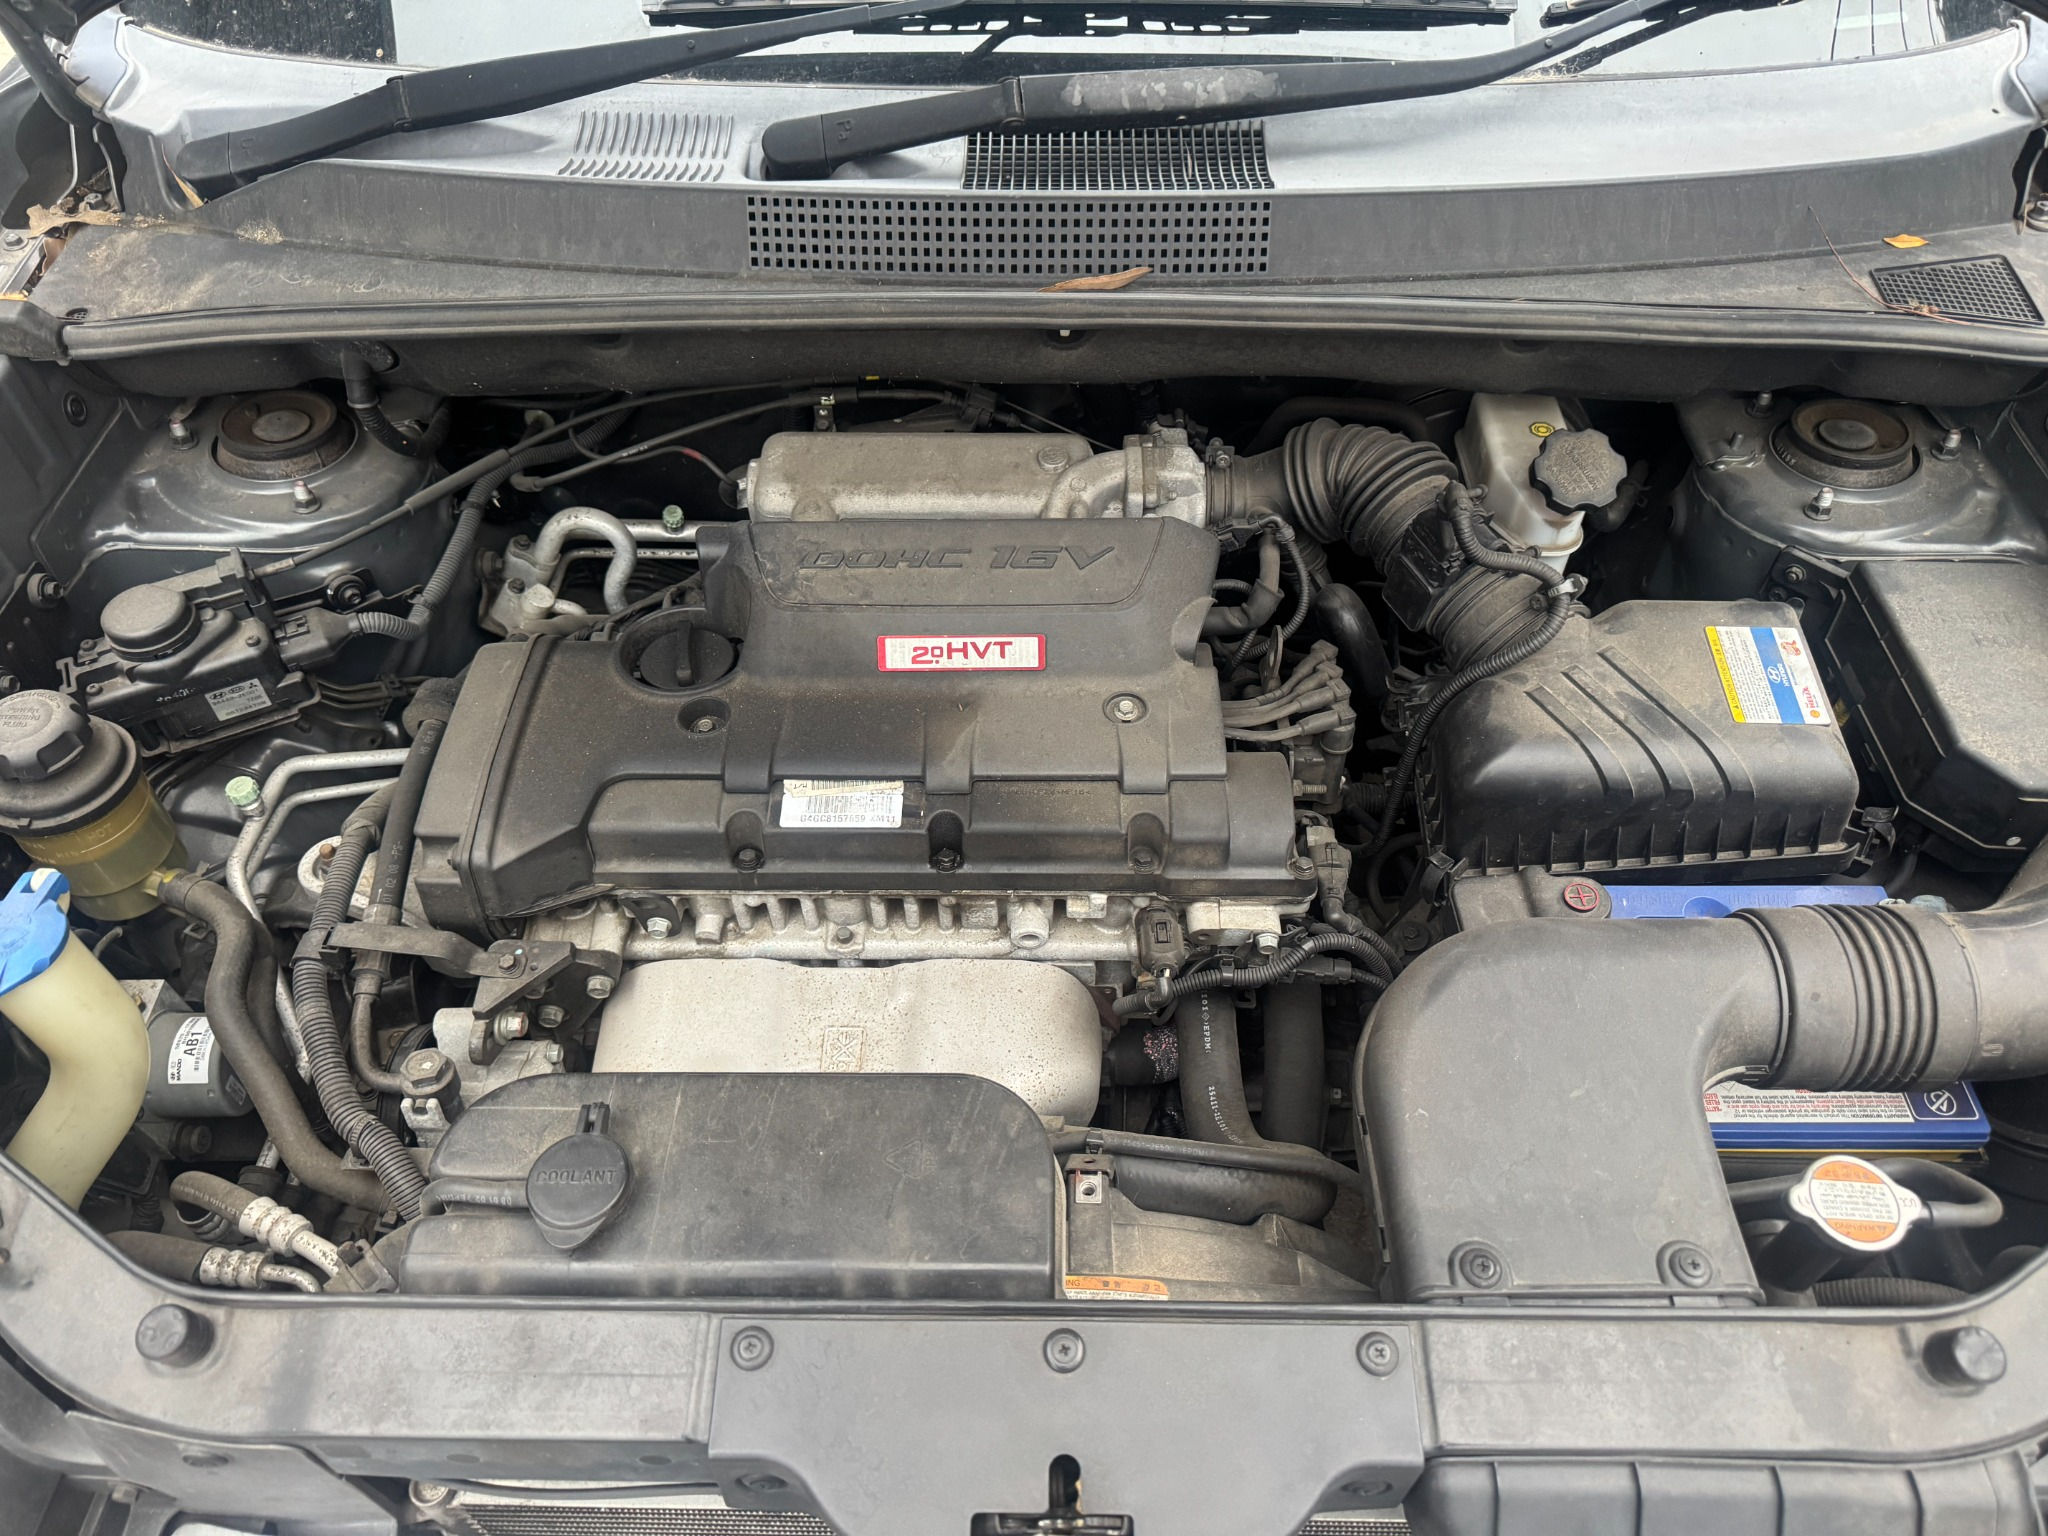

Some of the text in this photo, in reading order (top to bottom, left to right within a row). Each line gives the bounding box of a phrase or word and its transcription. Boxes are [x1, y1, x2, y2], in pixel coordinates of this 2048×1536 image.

[800, 545, 1115, 570] DOHC 16V
[184, 1032, 202, 1056] AB1
[536, 1169, 617, 1185] COOLANT
